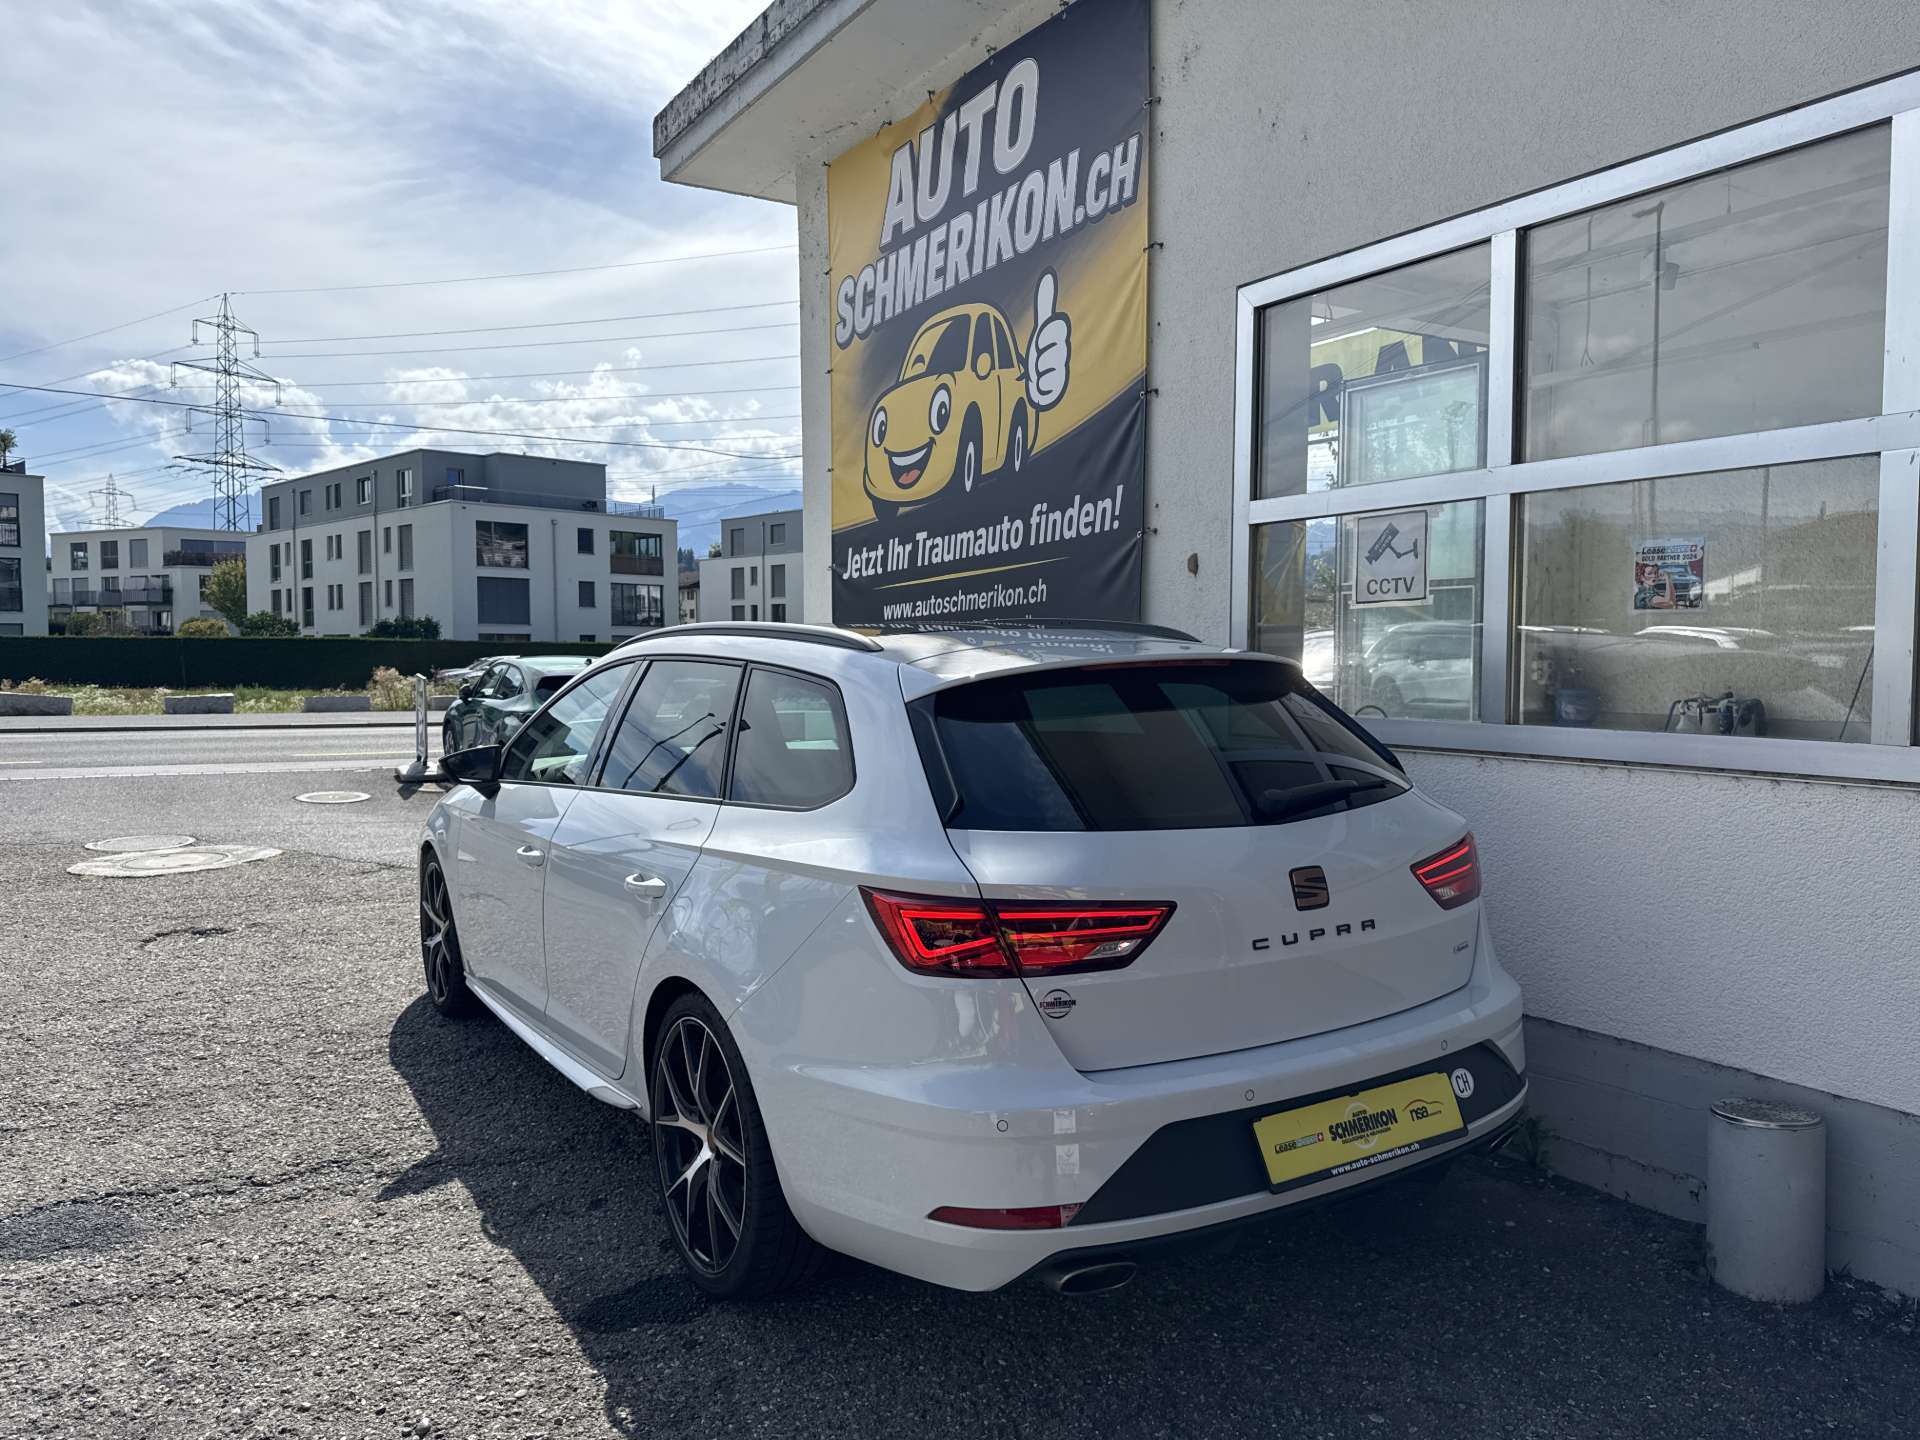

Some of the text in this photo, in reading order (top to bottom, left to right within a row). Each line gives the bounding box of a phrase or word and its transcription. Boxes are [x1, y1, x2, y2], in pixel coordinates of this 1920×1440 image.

[879, 57, 1040, 250] AUTO
[835, 131, 1142, 347] SCHMERIKON.CH
[842, 485, 1124, 580] Jetzt Ihr Traumauto finden!
[883, 579, 1047, 621] www.autoschmerikon.ch
[1366, 577, 1415, 596] CCTV
[1252, 918, 1376, 951] CUPRA
[1455, 1072, 1471, 1094] CH
[1328, 1108, 1398, 1141] SCHMERIKON
[1409, 1106, 1429, 1121] nsa
[1331, 1143, 1420, 1175] www.auto-schmerikon.ch
